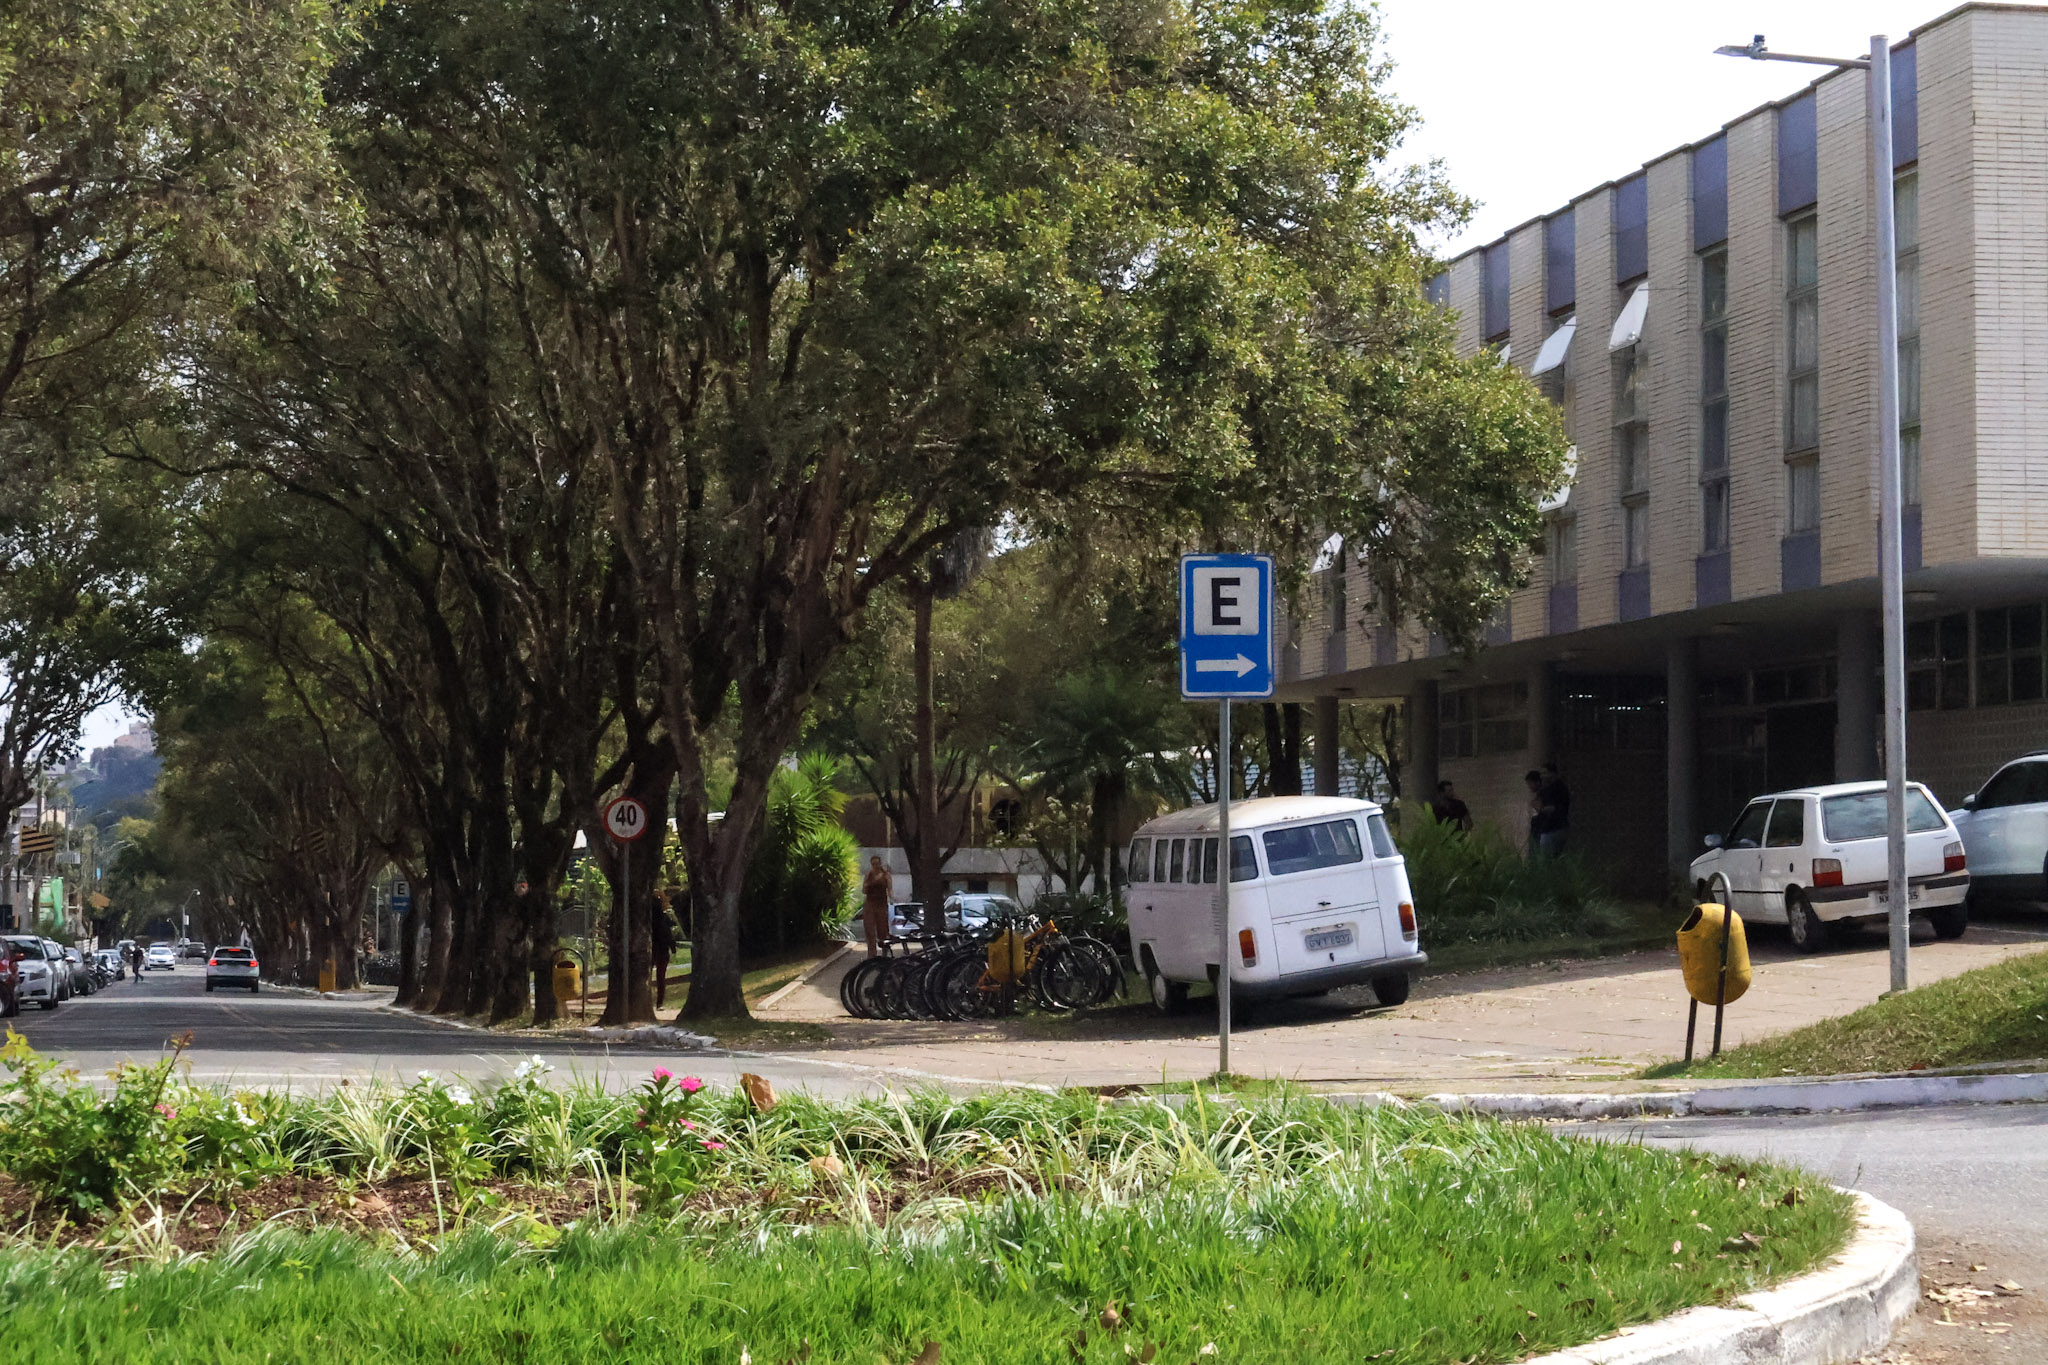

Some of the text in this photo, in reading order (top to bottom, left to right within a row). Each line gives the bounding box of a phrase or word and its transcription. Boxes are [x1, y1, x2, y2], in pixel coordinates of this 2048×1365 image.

[1211, 577, 1241, 626] E
[615, 804, 637, 826] 40
[397, 883, 406, 895] E
